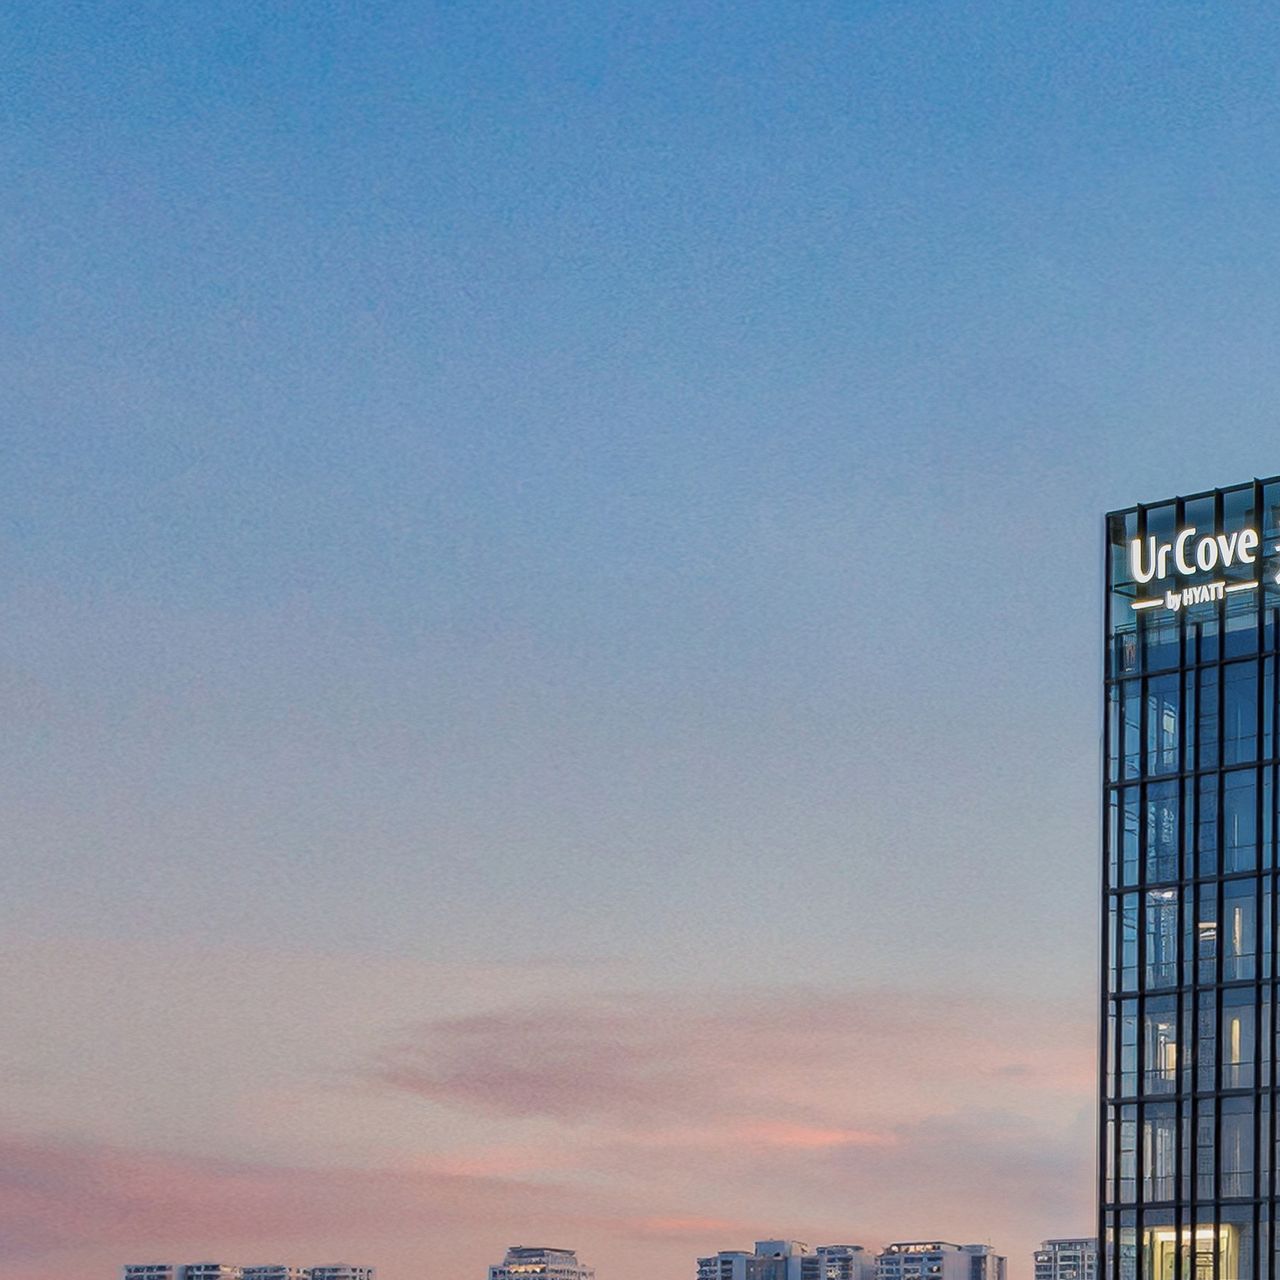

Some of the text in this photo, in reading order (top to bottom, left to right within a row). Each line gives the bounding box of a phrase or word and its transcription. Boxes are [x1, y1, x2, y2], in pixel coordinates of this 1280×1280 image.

[1130, 524, 1259, 585] UrCove
[1166, 581, 1226, 613] by HYATT
